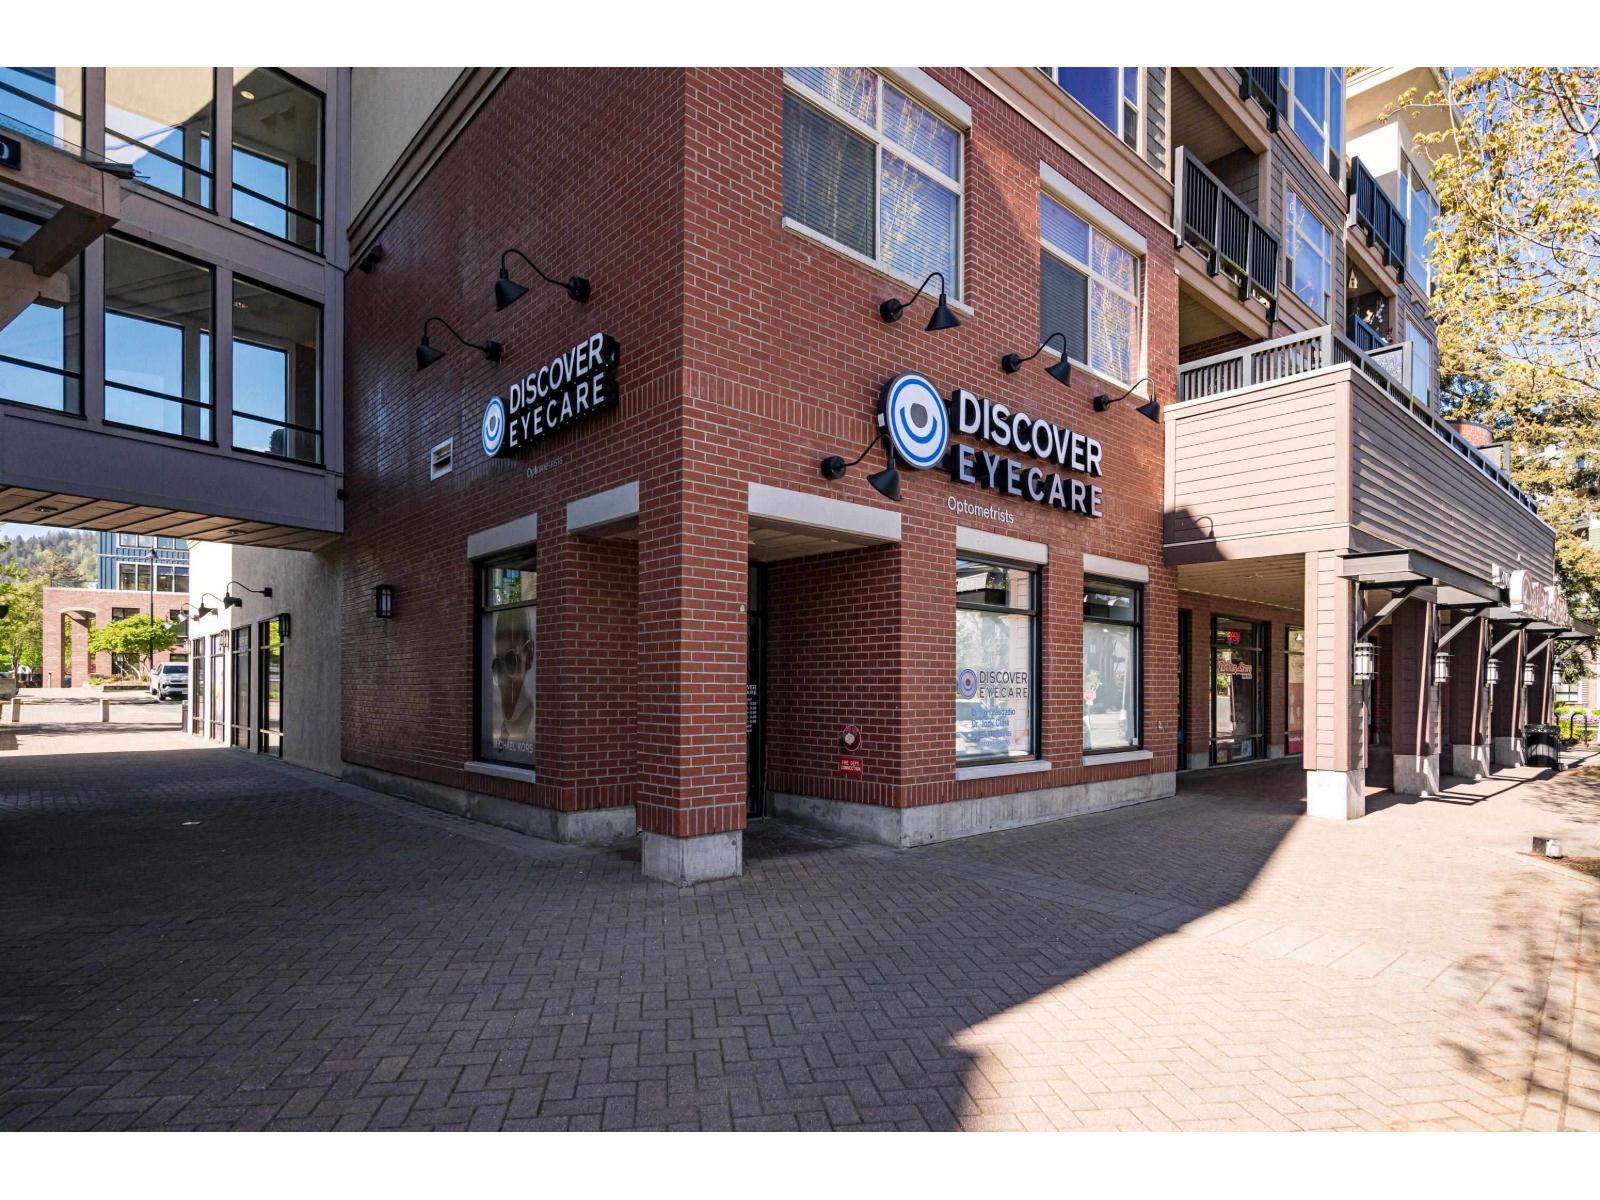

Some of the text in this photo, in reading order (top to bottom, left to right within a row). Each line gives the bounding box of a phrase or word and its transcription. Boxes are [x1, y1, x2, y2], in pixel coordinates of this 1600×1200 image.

[510, 332, 604, 413] DISCOVER
[509, 372, 605, 448] EYECARE
[959, 389, 1103, 477] DISCOVER
[959, 444, 1103, 518] EYECARE
[947, 496, 1014, 524] Optometrists
[979, 671, 1028, 684] DISCOVER
[979, 687, 1028, 698] EYECARE
[517, 742, 534, 753] KORS
